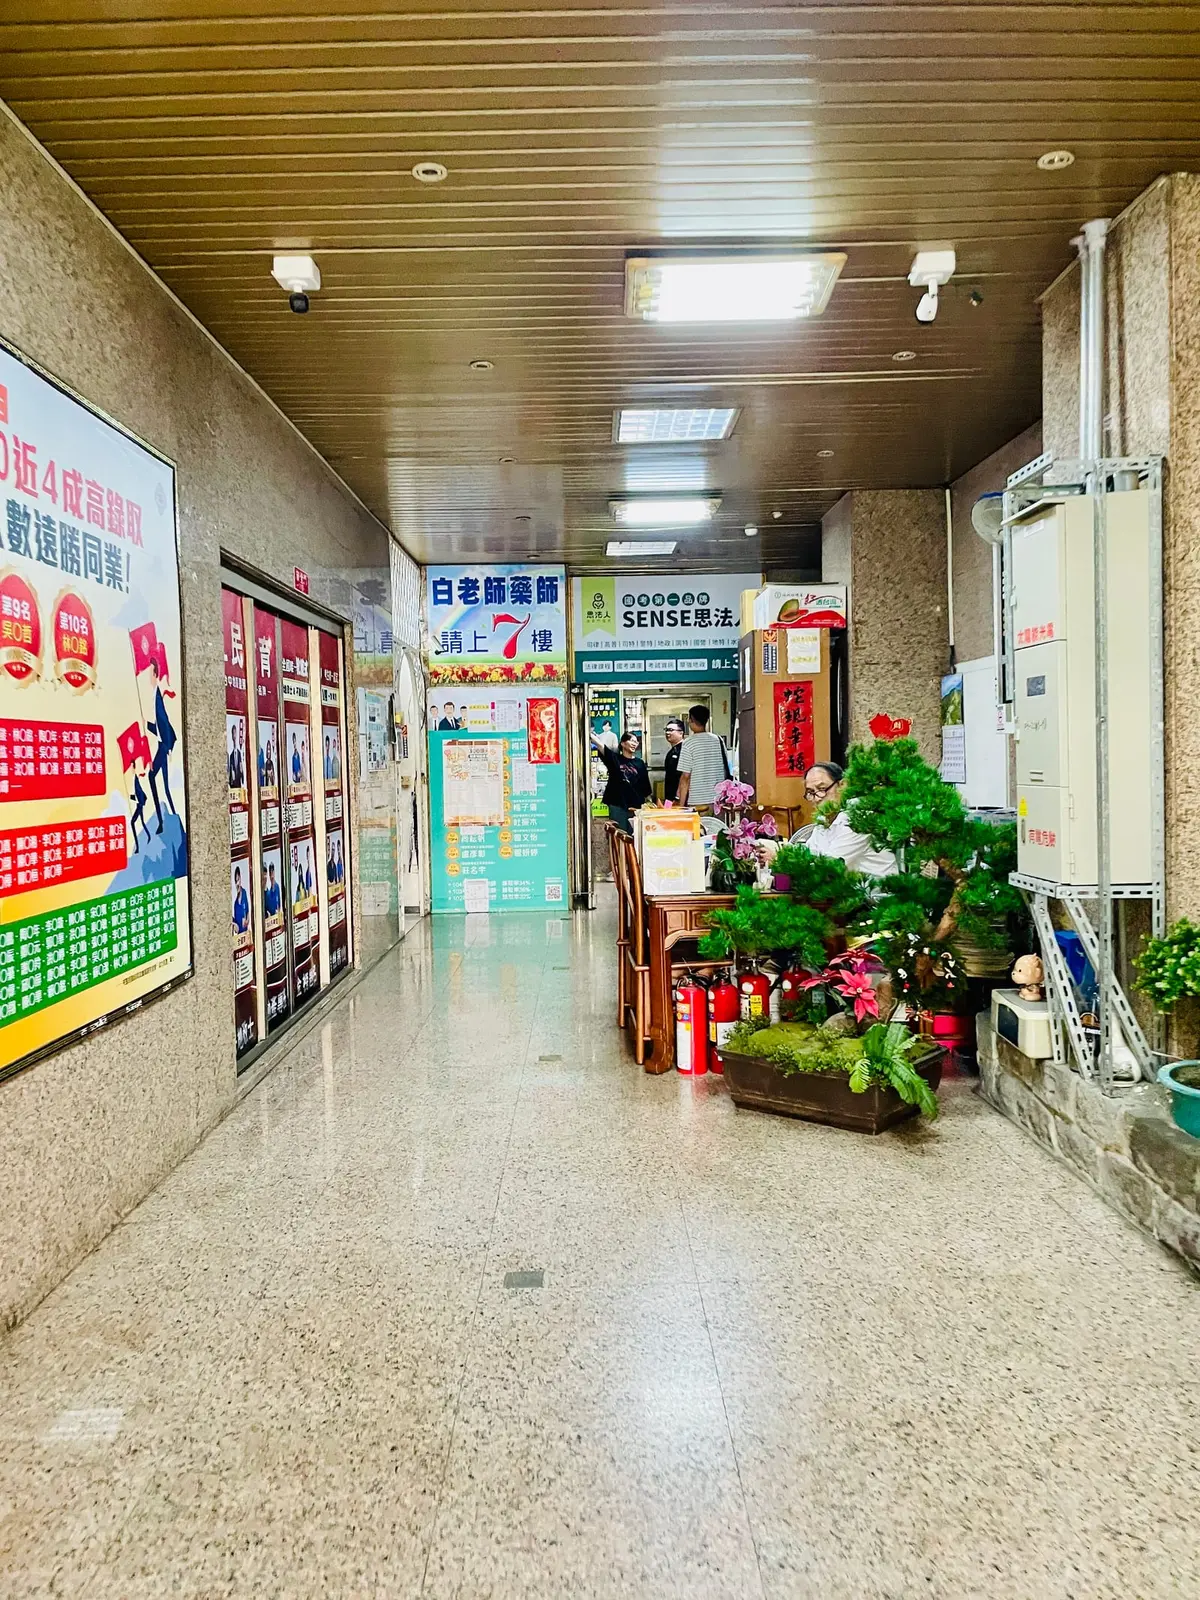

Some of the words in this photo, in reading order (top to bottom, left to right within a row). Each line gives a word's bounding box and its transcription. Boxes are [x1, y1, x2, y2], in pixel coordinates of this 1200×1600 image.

[0, 498, 130, 593] 數遠勝同業!
[432, 576, 558, 605] 白老師藥師
[622, 592, 710, 608] 國考第一品牌
[1, 594, 31, 621] 第9名
[586, 610, 611, 618] 思法人
[622, 608, 740, 628] SENSE思法
[60, 611, 88, 636] 第10名
